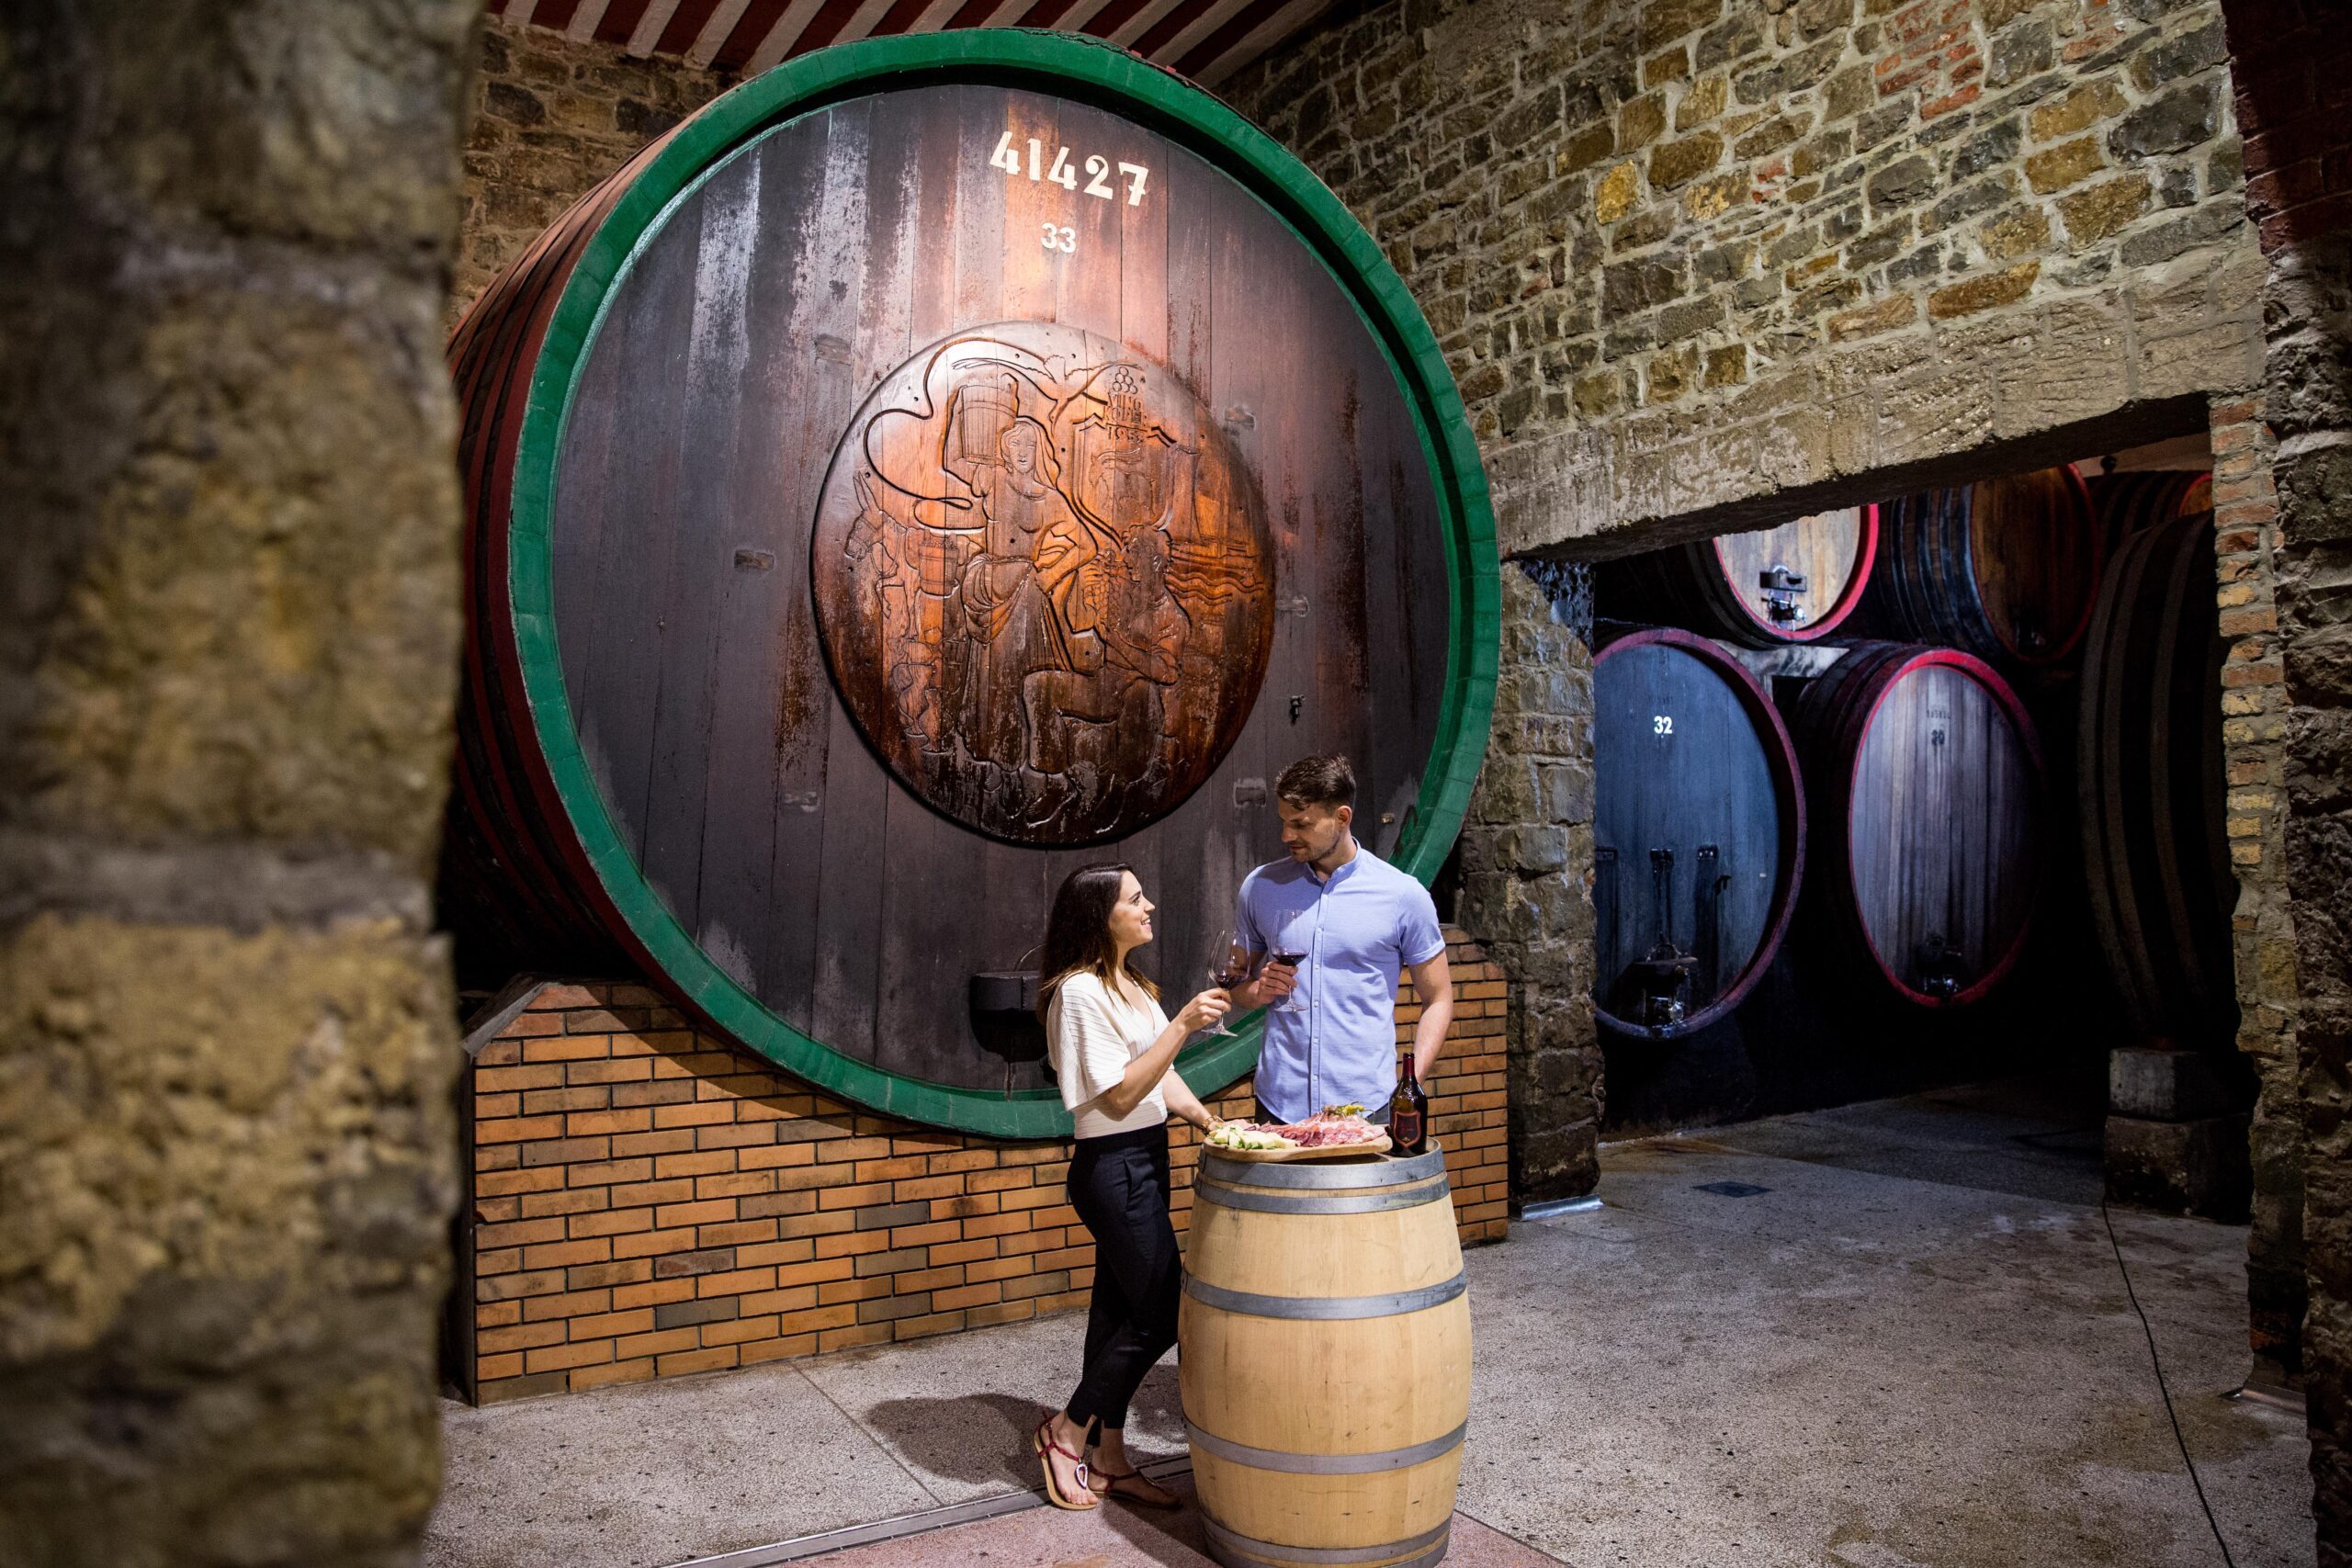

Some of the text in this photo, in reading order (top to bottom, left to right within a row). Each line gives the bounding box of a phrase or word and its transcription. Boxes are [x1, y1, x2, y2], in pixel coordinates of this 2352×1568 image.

[989, 131, 1148, 207] 41427
[1041, 222, 1077, 254] 33
[1654, 716, 1672, 734] 32
